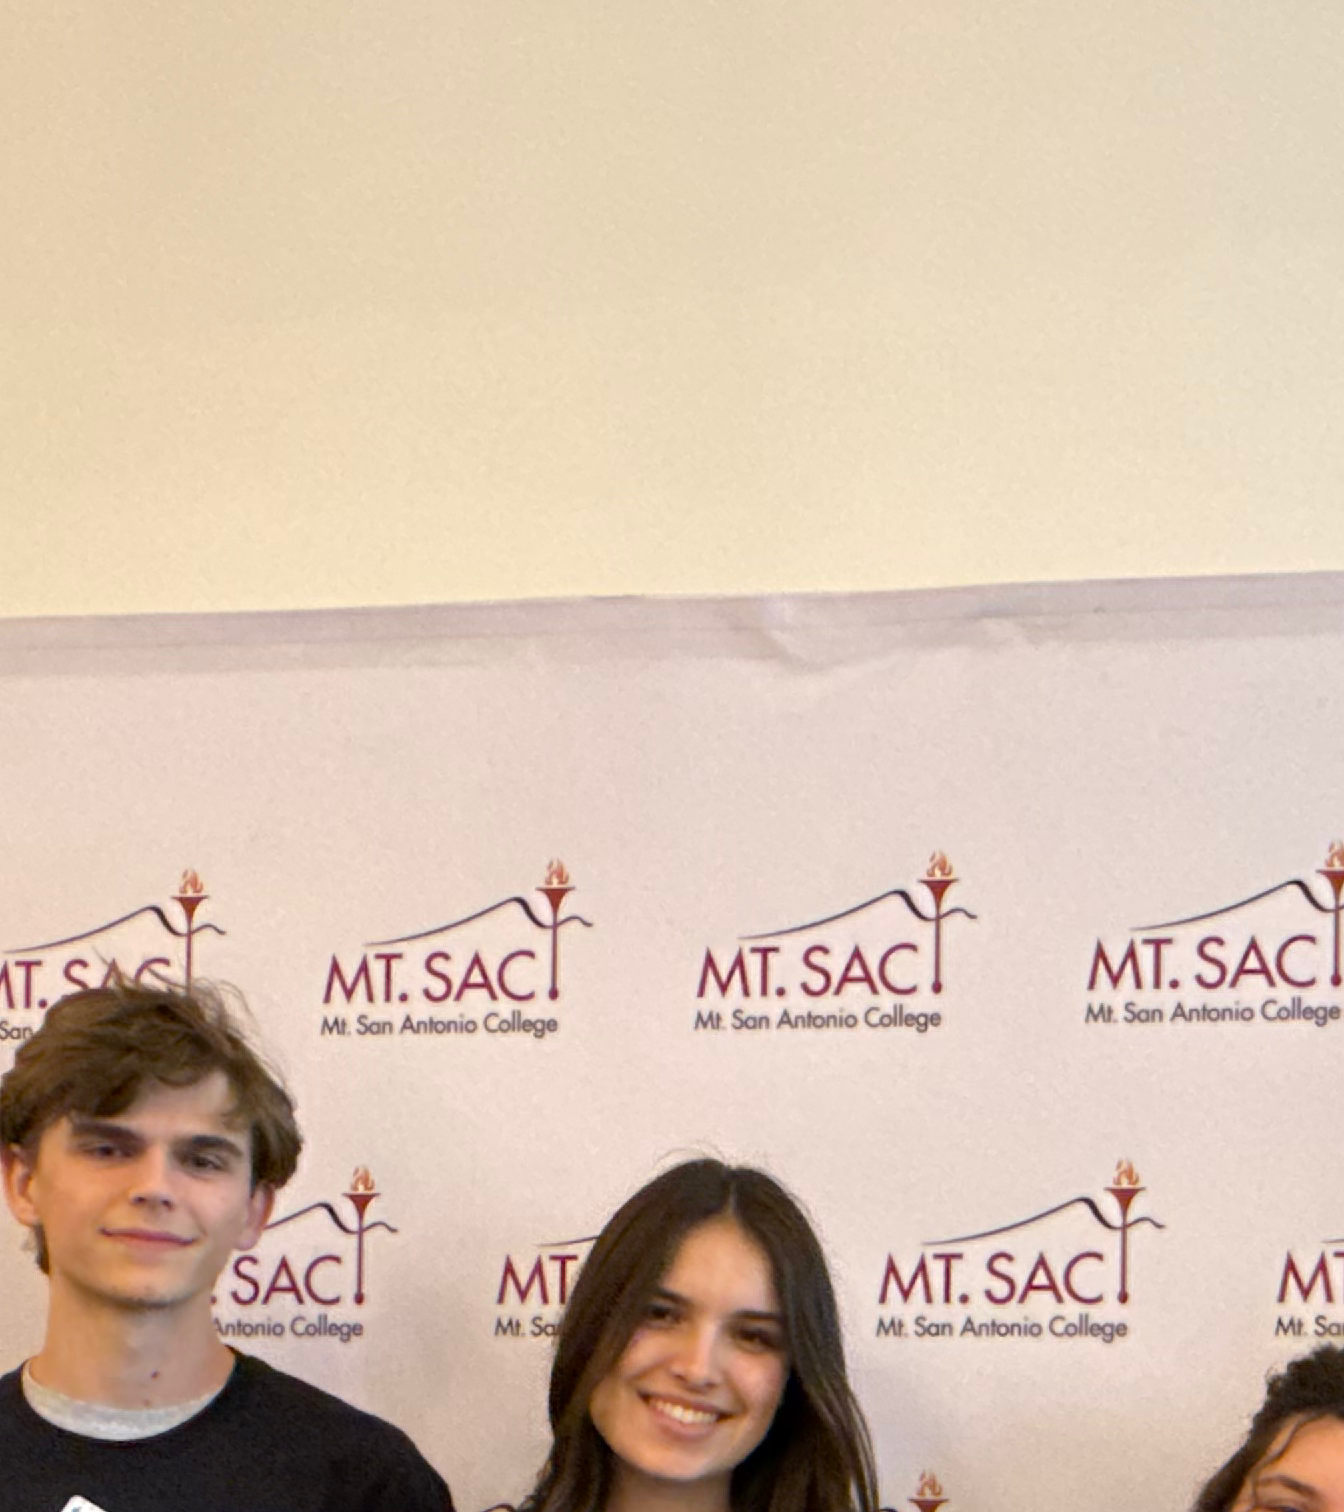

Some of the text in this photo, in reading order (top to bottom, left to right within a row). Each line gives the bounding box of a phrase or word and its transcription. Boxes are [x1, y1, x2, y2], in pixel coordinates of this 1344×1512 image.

[322, 951, 537, 1004] MT. SAC
[697, 943, 918, 998] MT. SAC
[1087, 935, 1317, 990] MT. SAC
[320, 1011, 559, 1039] Mt. San Antonio College
[694, 1003, 943, 1033] Mt. San Antonio College
[1085, 996, 1341, 1025] Mt. San Antonio College
[231, 1254, 342, 1305] SAC
[497, 1254, 578, 1305] MT
[879, 1250, 1104, 1305] MT. SAC
[290, 1313, 364, 1343] College
[495, 1316, 556, 1337] Mt. Sa
[876, 1312, 1128, 1343] Mt. San Antonio College
[1275, 1316, 1306, 1337] Mt.
